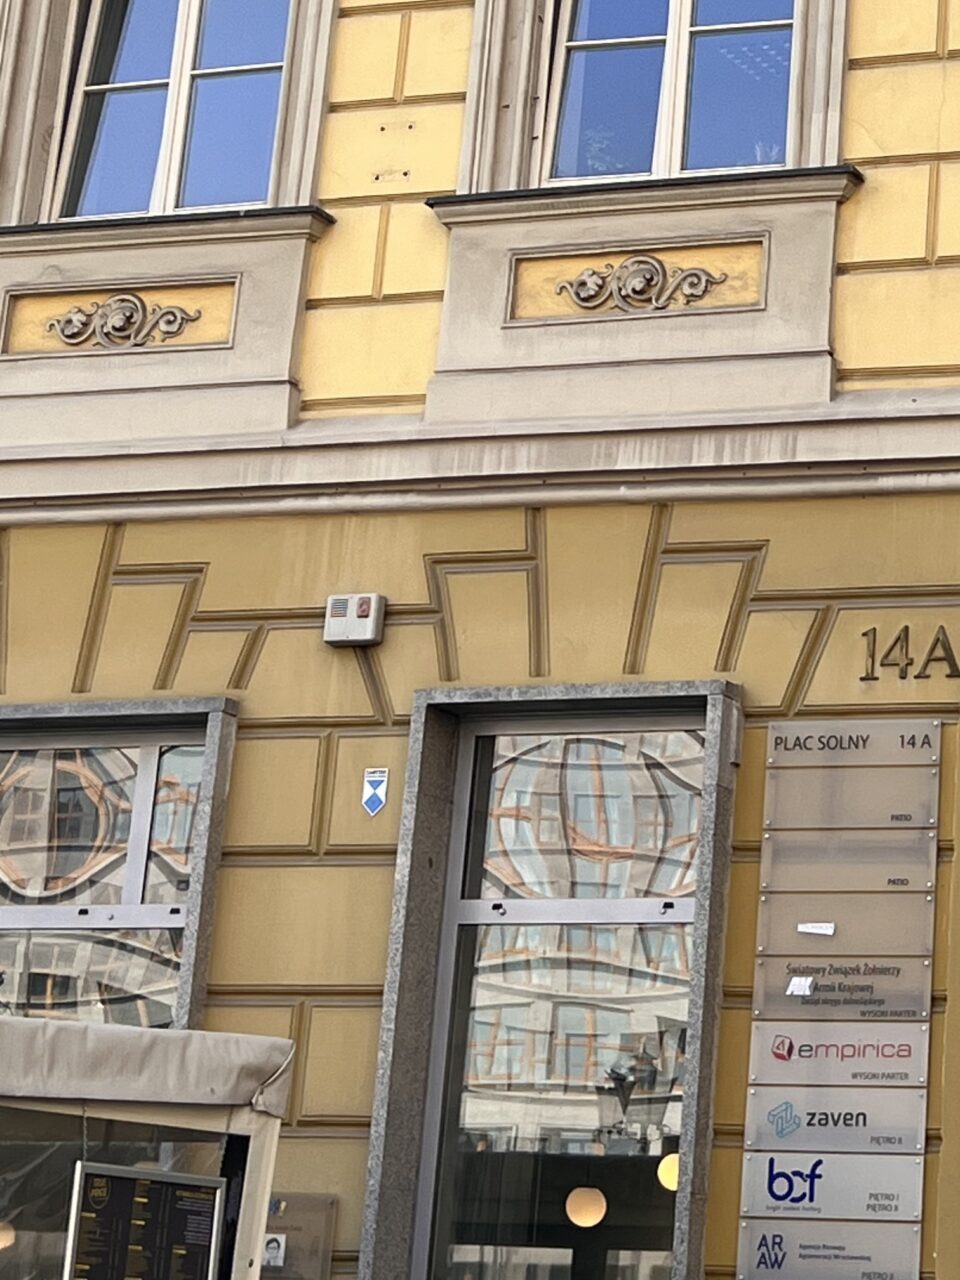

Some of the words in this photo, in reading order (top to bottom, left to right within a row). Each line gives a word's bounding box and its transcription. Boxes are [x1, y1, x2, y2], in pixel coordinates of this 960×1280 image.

[774, 736, 813, 751] PLAC
[818, 734, 870, 751] SOLNY
[899, 734, 916, 749] 14
[920, 734, 932, 748] A
[890, 814, 912, 822] PATIO
[887, 878, 909, 886] PATIO
[827, 964, 861, 977] Związek
[798, 1039, 912, 1061] empirica
[806, 1111, 867, 1127] zaven
[868, 1193, 895, 1203] PIĘTRO
[866, 1204, 893, 1213] PIĘTRO
[757, 1234, 783, 1252] AR
[756, 1251, 787, 1269] AW
